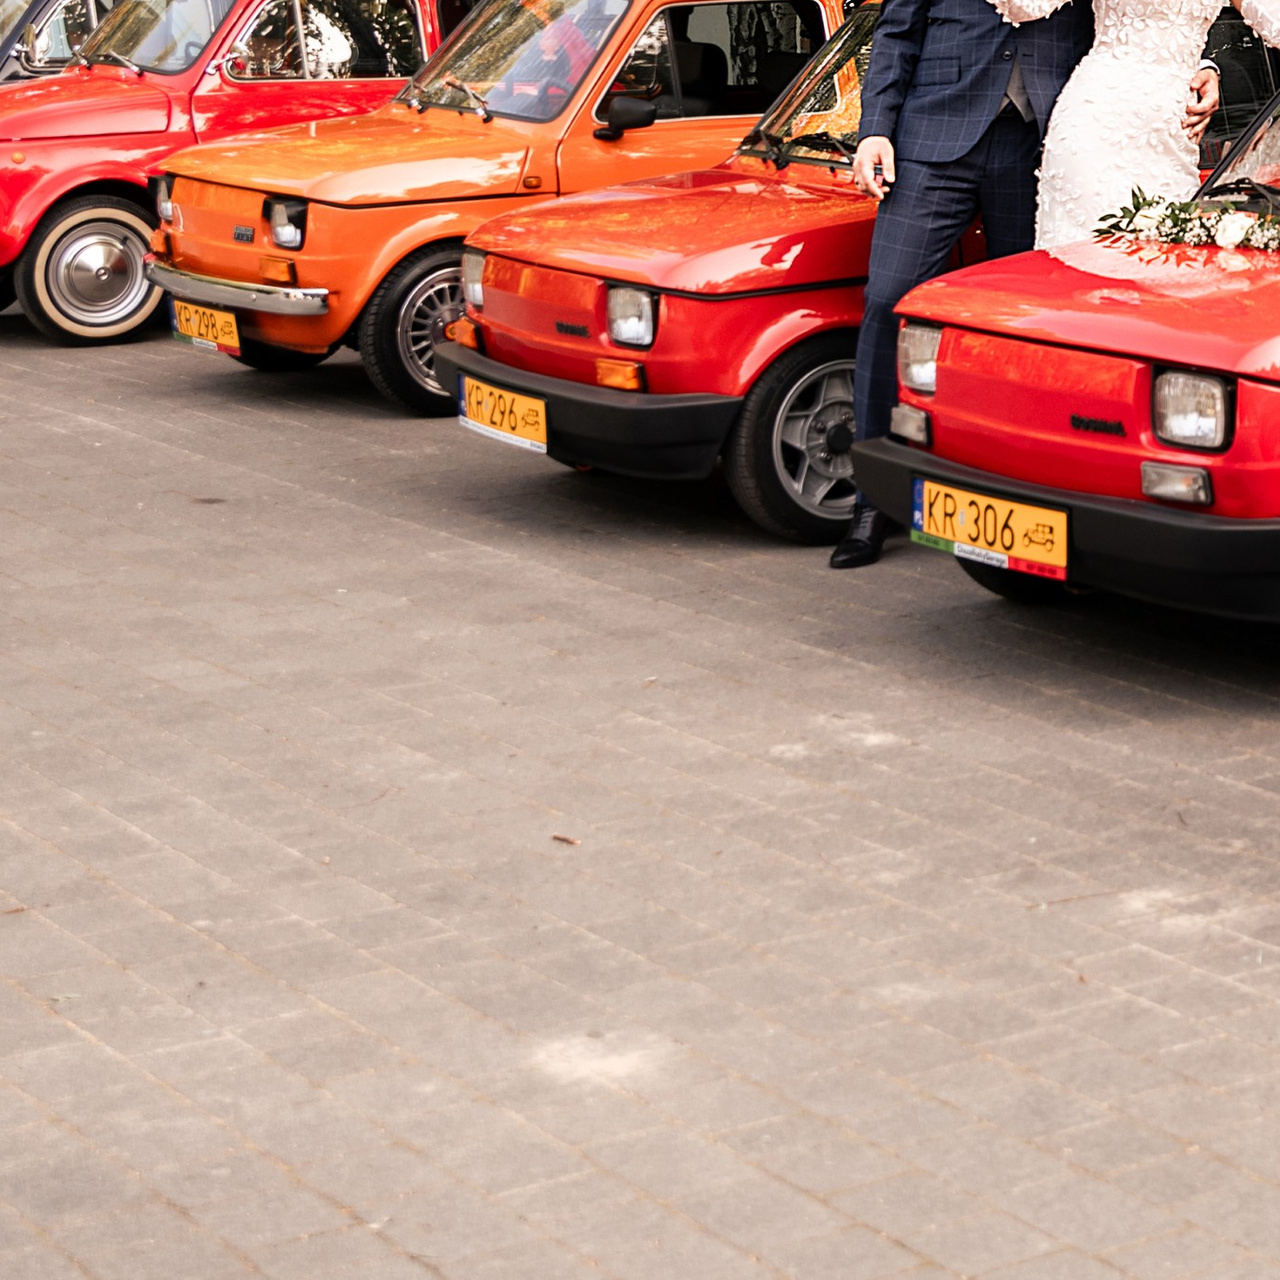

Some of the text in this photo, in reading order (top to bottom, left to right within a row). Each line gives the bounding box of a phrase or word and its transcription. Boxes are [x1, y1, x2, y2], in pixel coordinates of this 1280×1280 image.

[177, 303, 219, 340] KR 298
[467, 380, 485, 421] KR
[488, 390, 518, 431] 296
[928, 488, 1015, 551] KR 306
